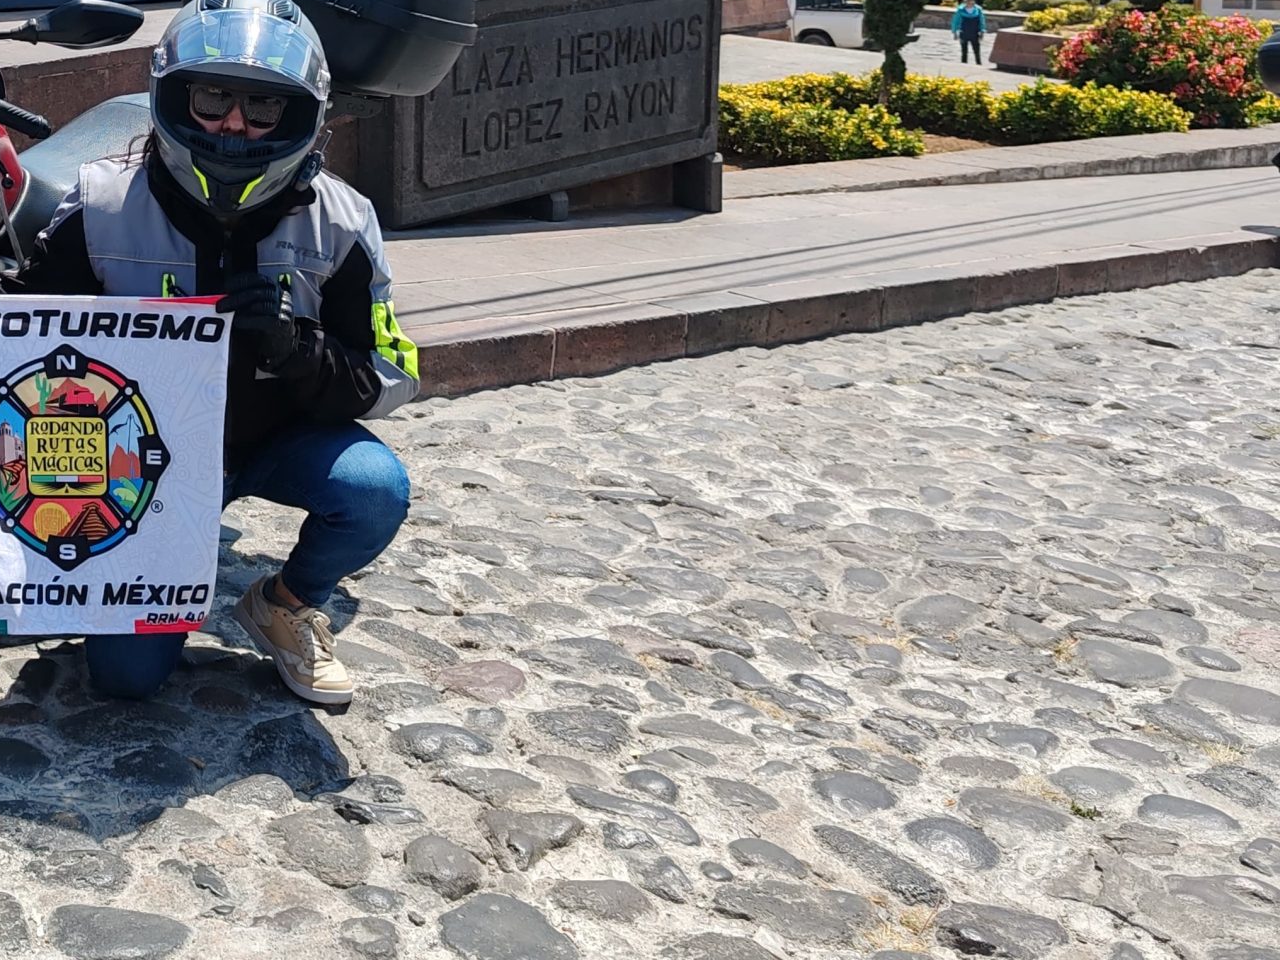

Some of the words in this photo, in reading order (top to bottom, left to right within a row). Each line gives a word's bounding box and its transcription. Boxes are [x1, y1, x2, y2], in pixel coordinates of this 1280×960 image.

[430, 45, 534, 101] LAZA
[557, 14, 702, 78] HERMANOS
[461, 98, 564, 158] LOPEZ
[583, 76, 675, 133] RAYON
[56, 355, 76, 370] N
[146, 449, 163, 464] E
[59, 544, 77, 560] S
[102, 575, 209, 606] MÉXICO
[146, 612, 180, 624] RRM
[184, 610, 205, 623] 4.0
